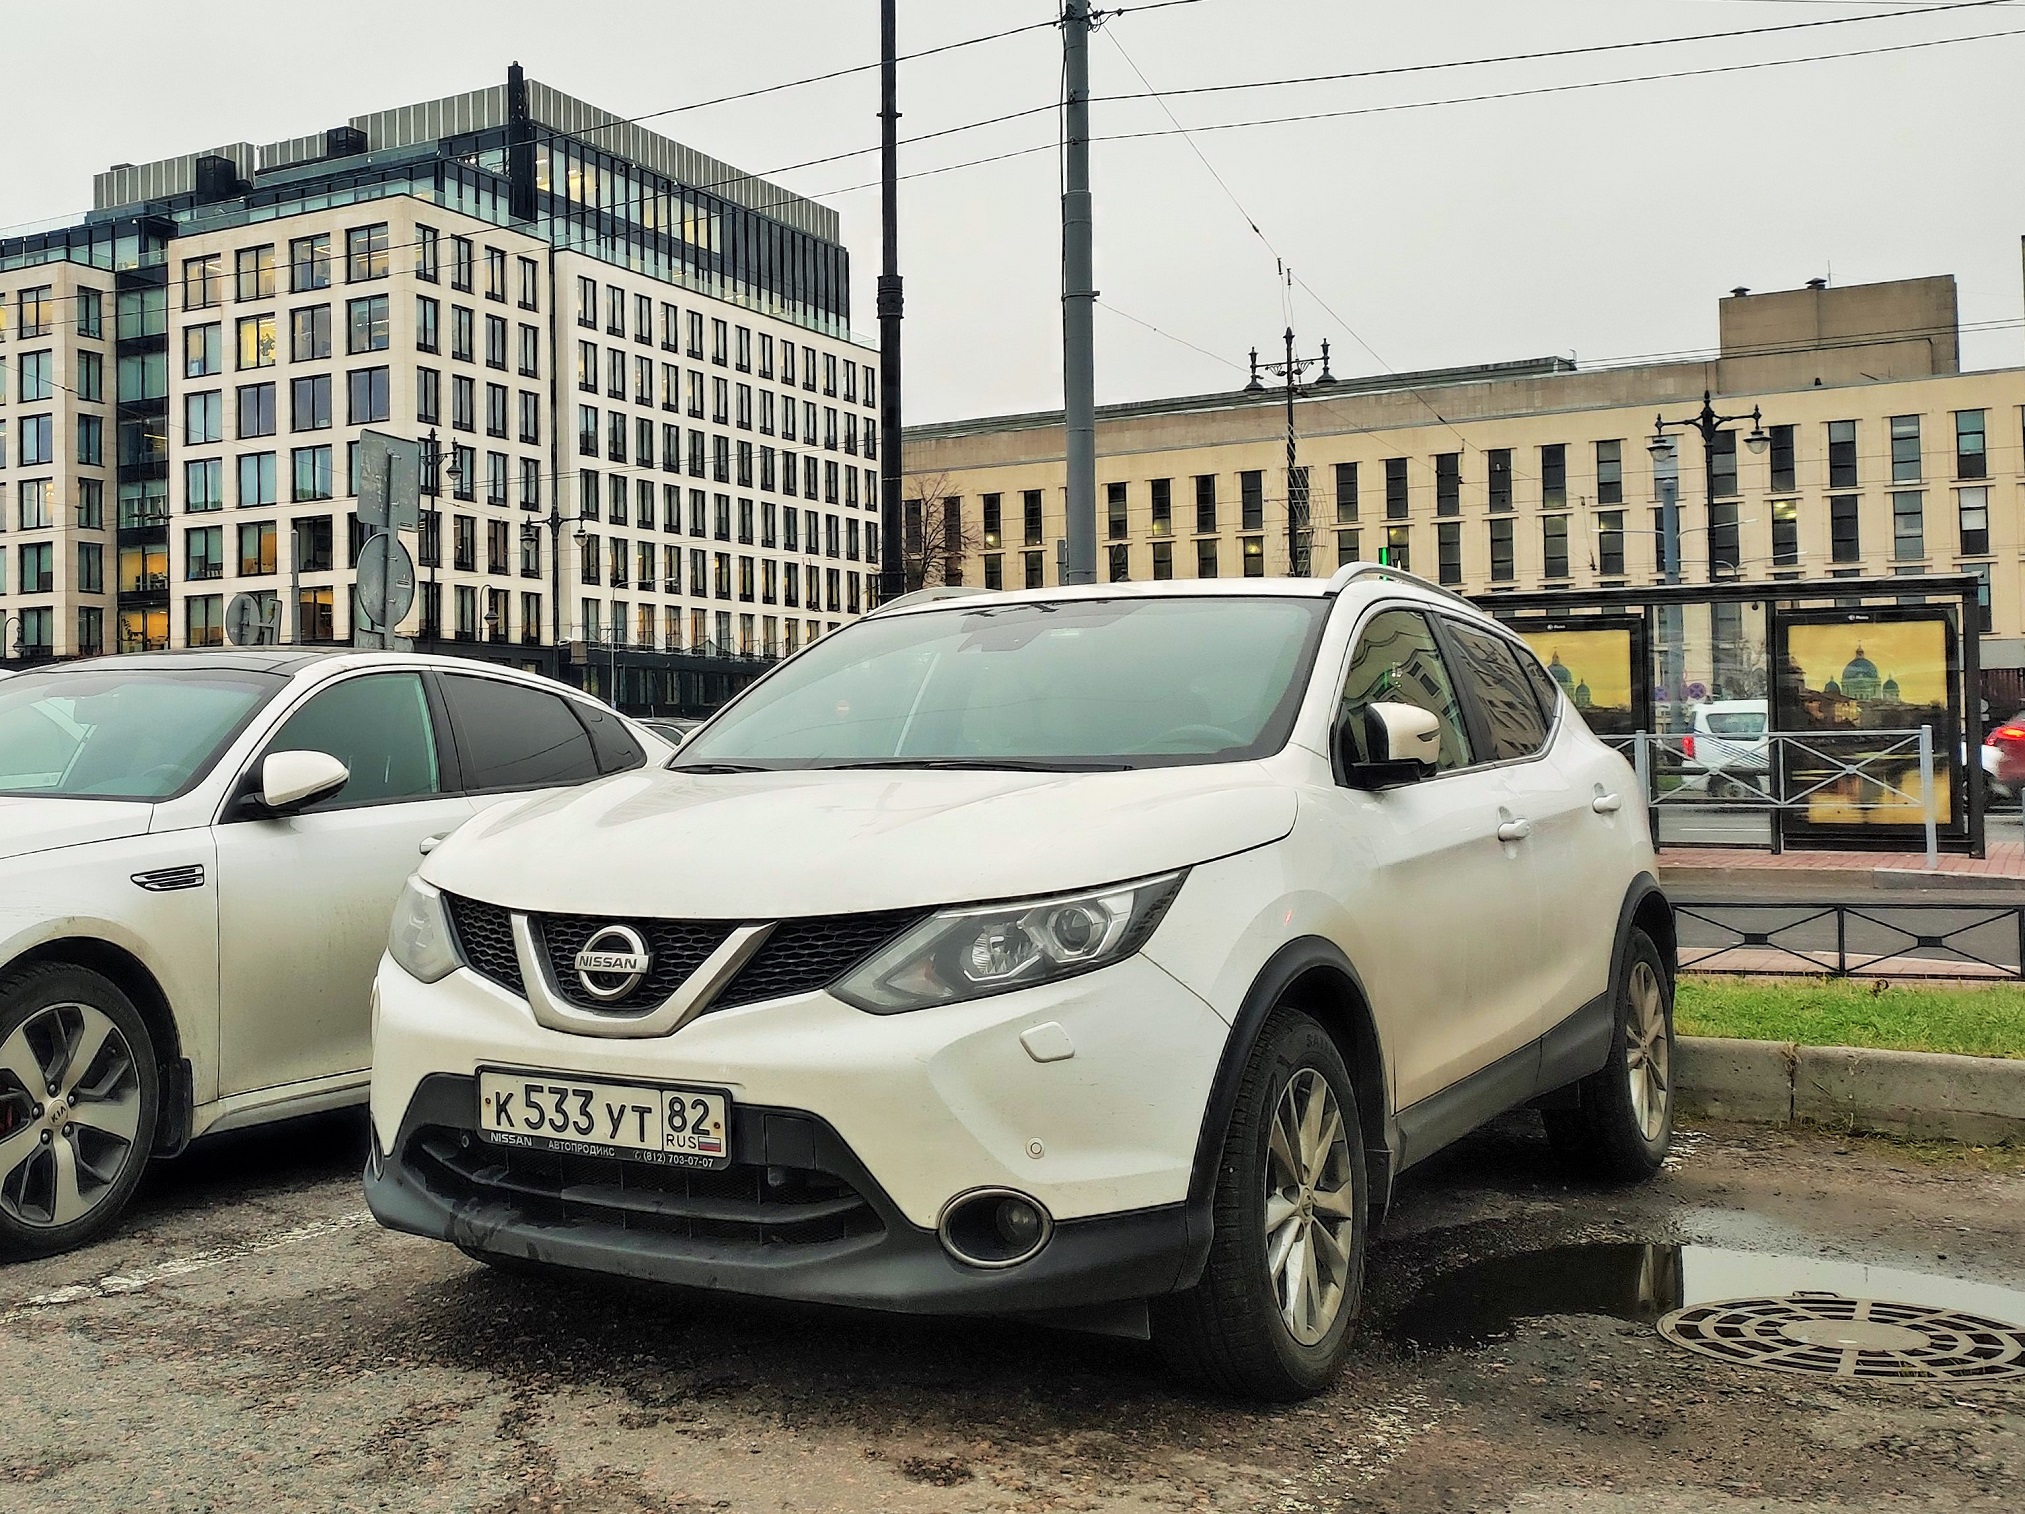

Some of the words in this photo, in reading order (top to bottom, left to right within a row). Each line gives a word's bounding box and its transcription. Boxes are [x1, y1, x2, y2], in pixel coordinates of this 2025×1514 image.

[579, 955, 637, 969] NISSAN
[51, 1105, 66, 1123] KIA
[667, 1096, 711, 1136] 82
[490, 1132, 532, 1147] NISSAN
[666, 1133, 697, 1149] RUS
[548, 1140, 615, 1157] АВТОПРОДИКС
[668, 1154, 714, 1168] 703-07-07
